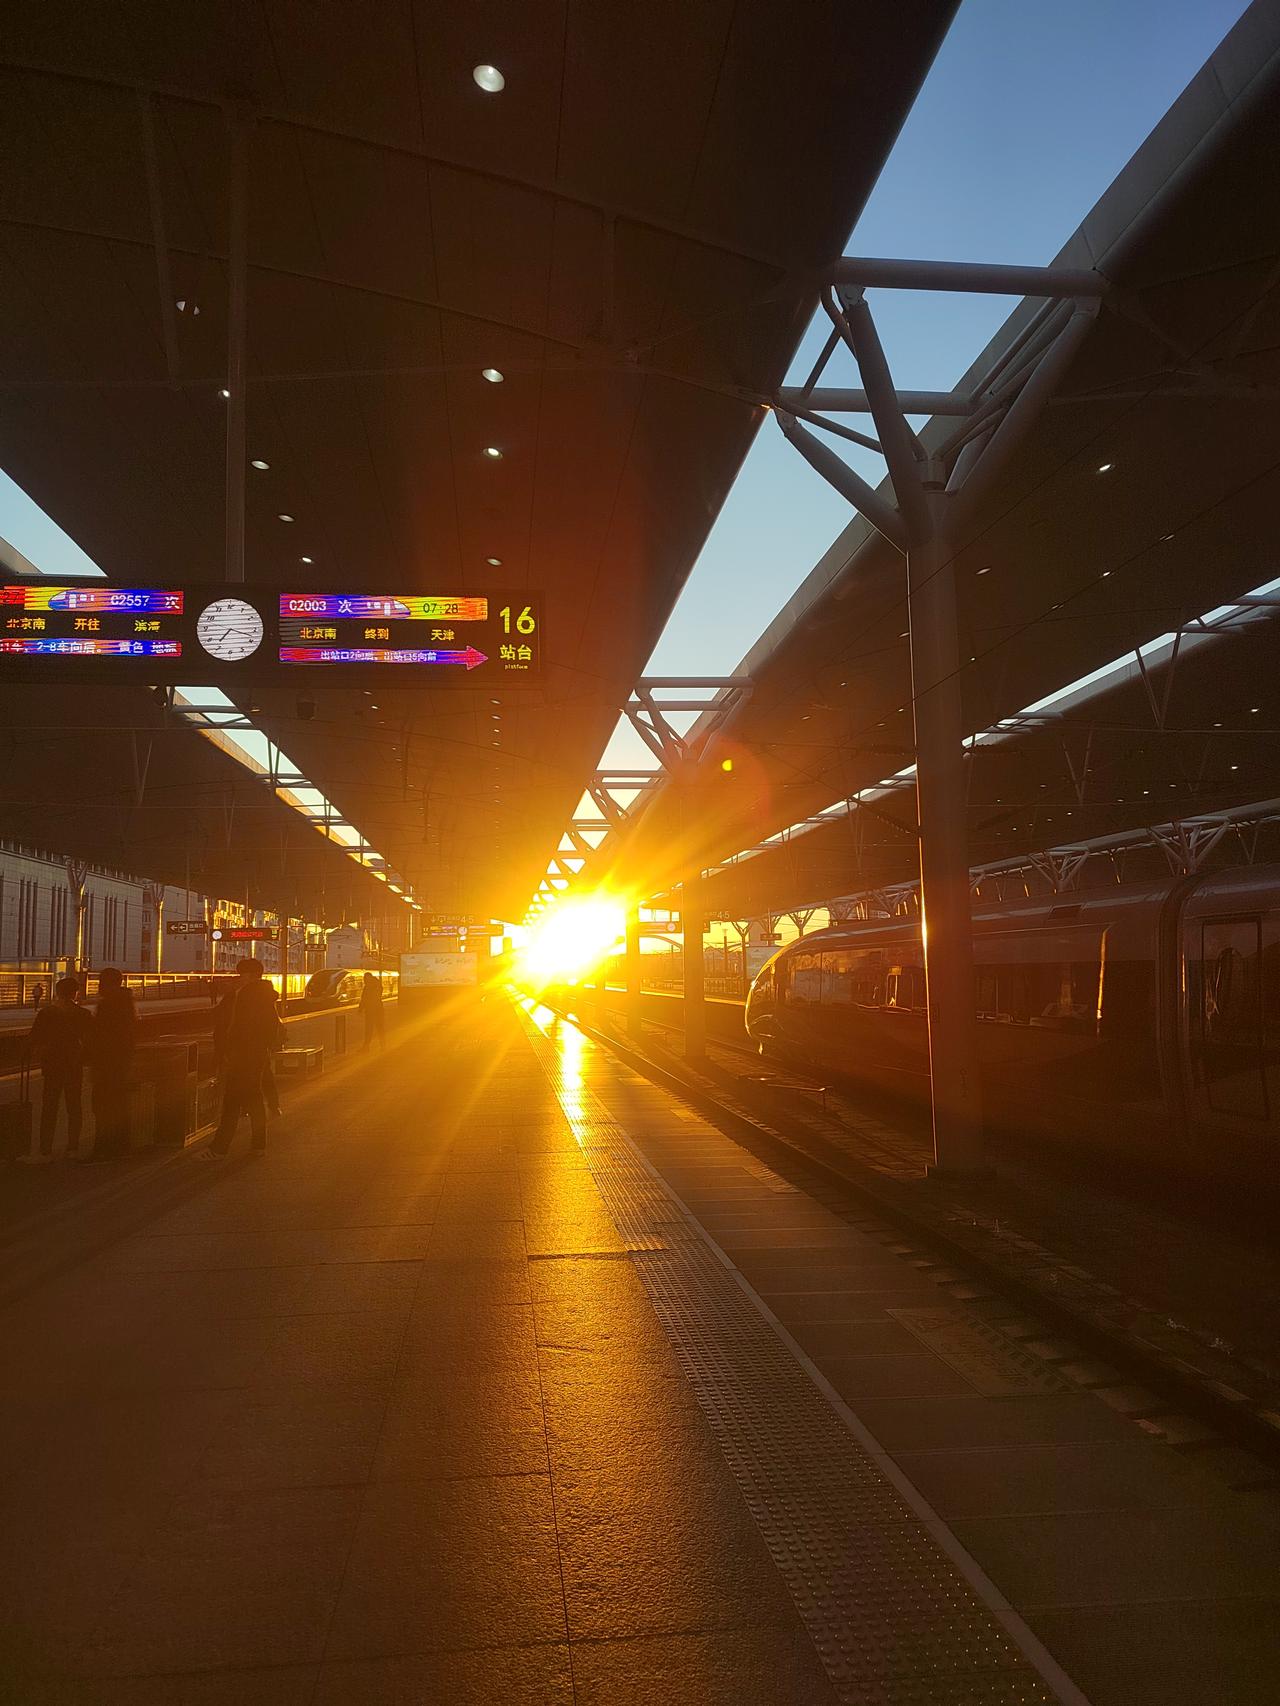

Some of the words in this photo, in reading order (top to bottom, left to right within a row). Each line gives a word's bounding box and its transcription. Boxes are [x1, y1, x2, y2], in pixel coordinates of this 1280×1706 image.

[164, 596, 180, 609] 次
[338, 599, 353, 613] 次
[423, 603, 459, 614] 07:28
[6, 617, 46, 630] 北京南
[74, 618, 101, 631] 开往
[500, 606, 535, 634] 16
[300, 627, 336, 639] 北京南
[364, 627, 389, 640] 终到
[431, 628, 455, 641] 天津
[500, 644, 532, 661] 站台
